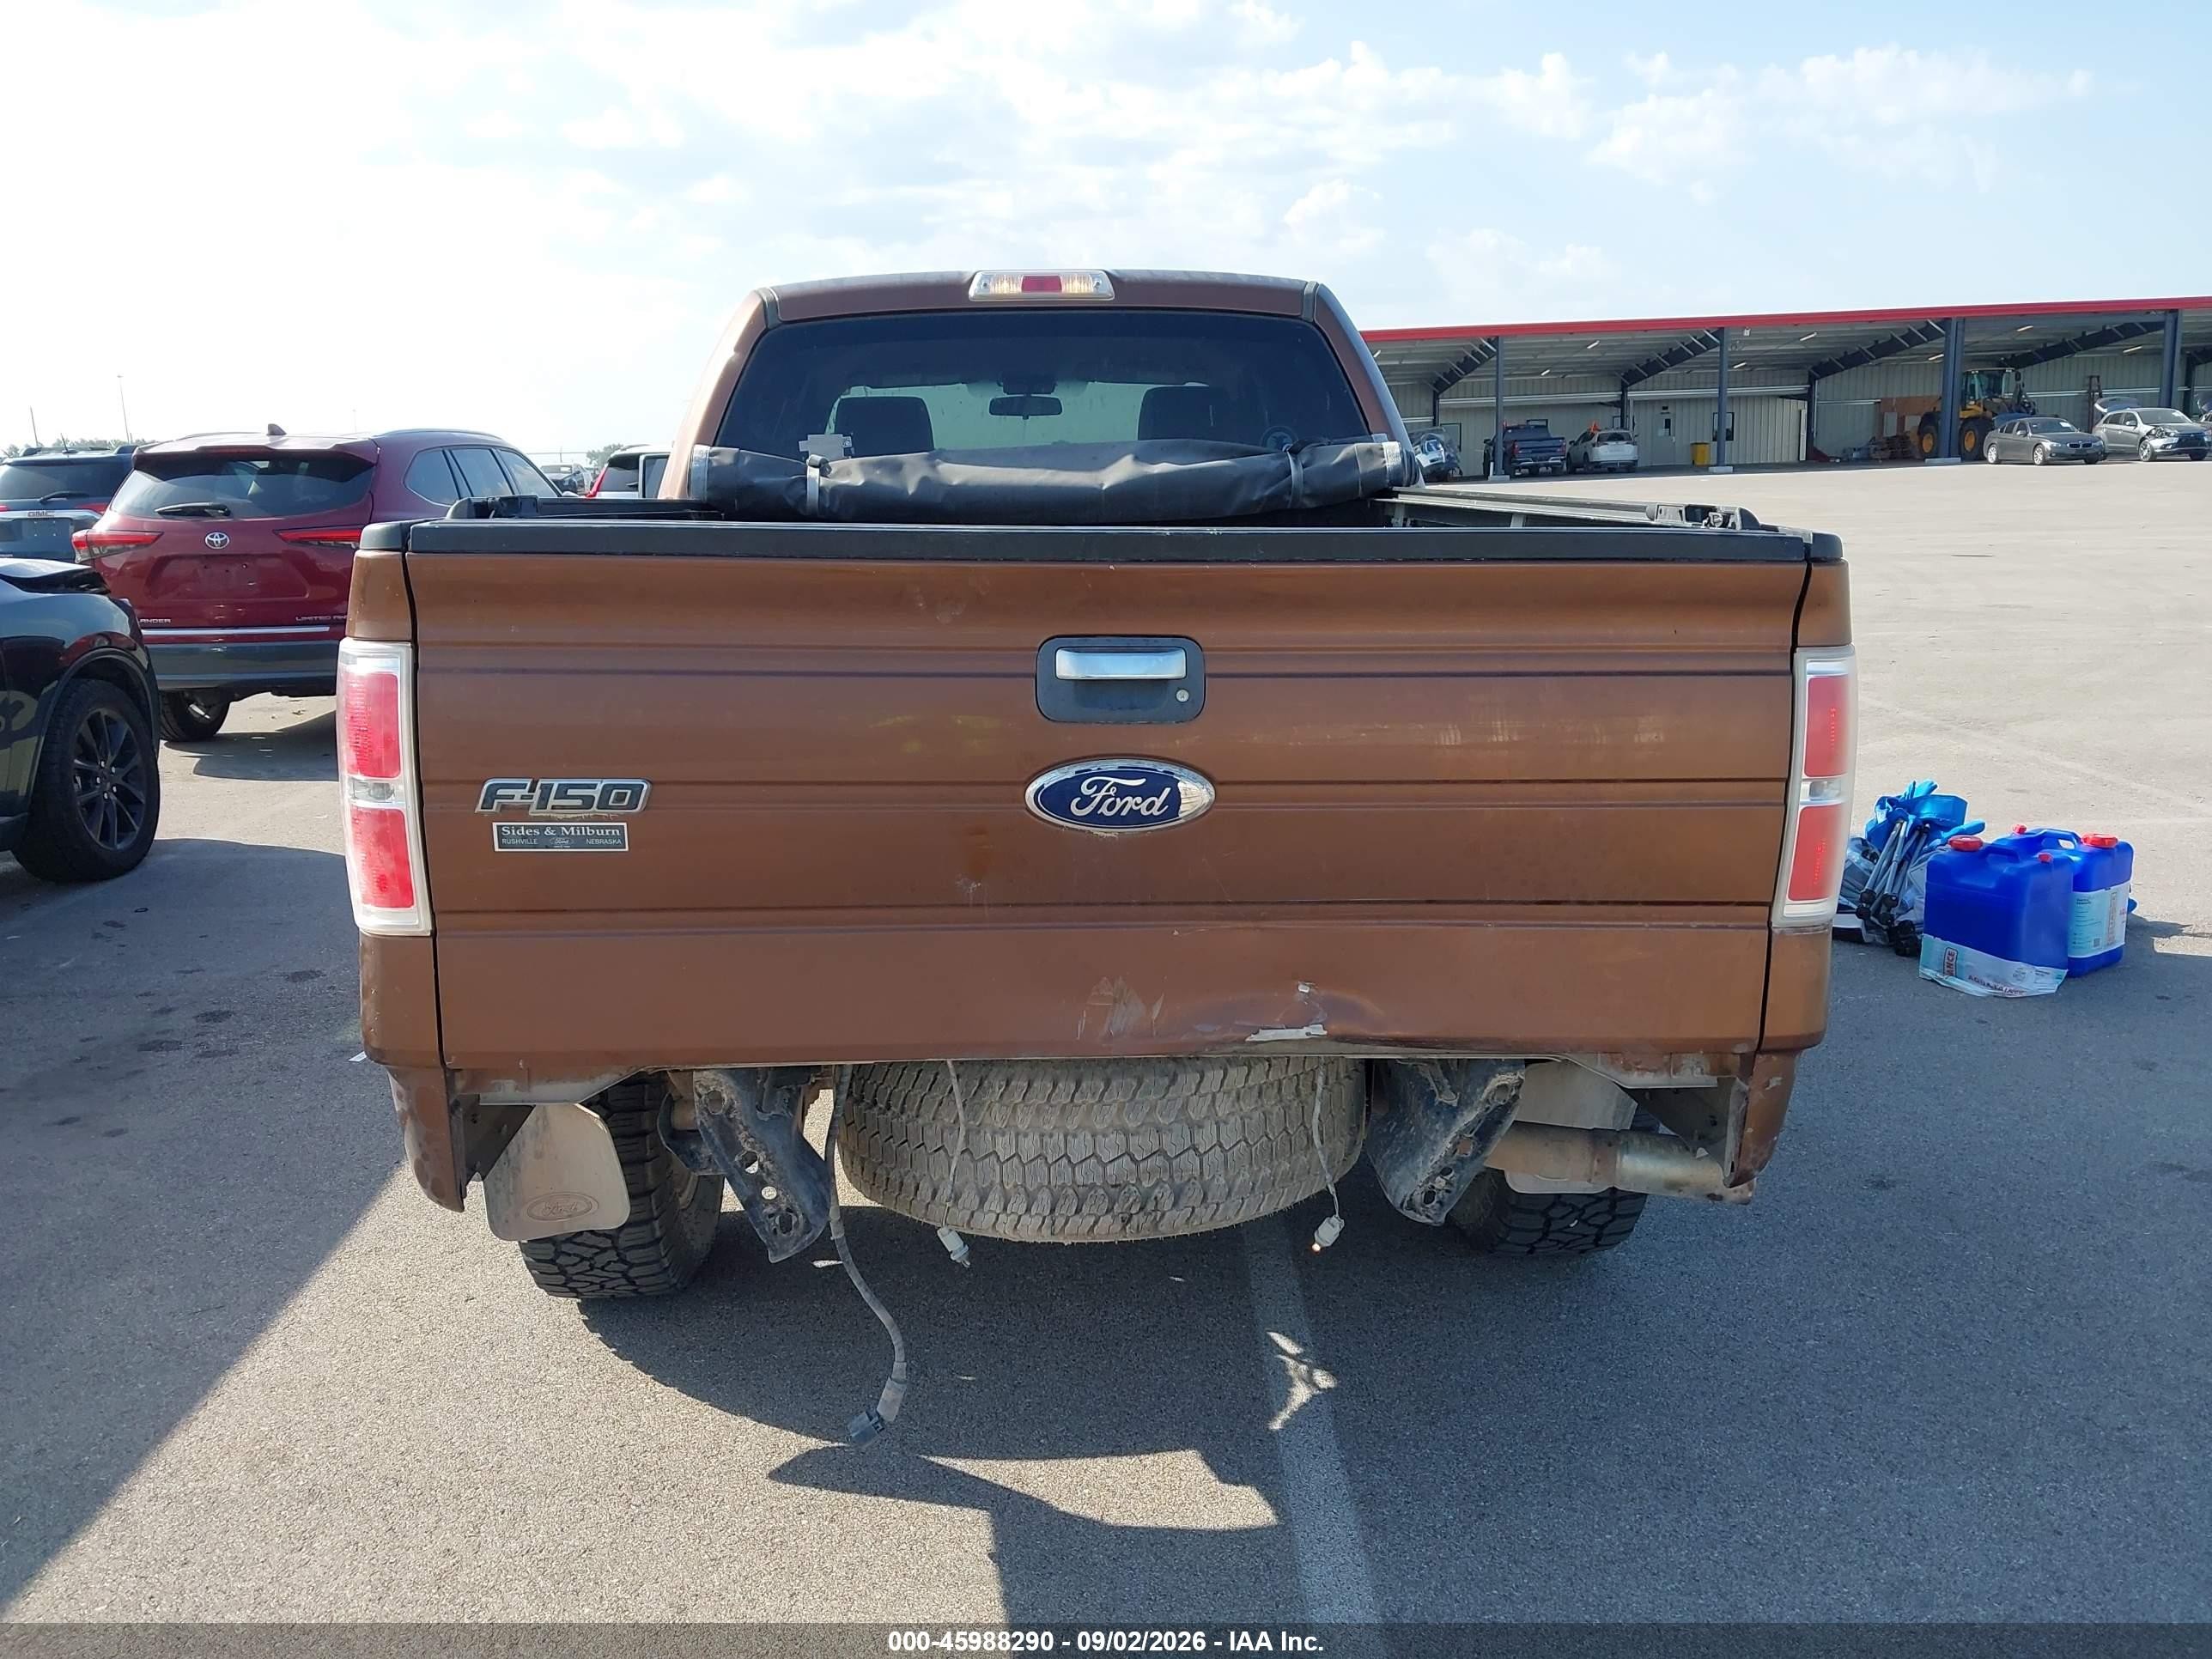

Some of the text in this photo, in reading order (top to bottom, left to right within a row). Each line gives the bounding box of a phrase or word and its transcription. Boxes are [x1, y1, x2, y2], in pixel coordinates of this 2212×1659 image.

[474, 777, 652, 814] F-150
[1070, 775, 1171, 817] Ford
[501, 826, 621, 836] Sides & Milburn
[586, 837, 623, 846] NEBRASKA
